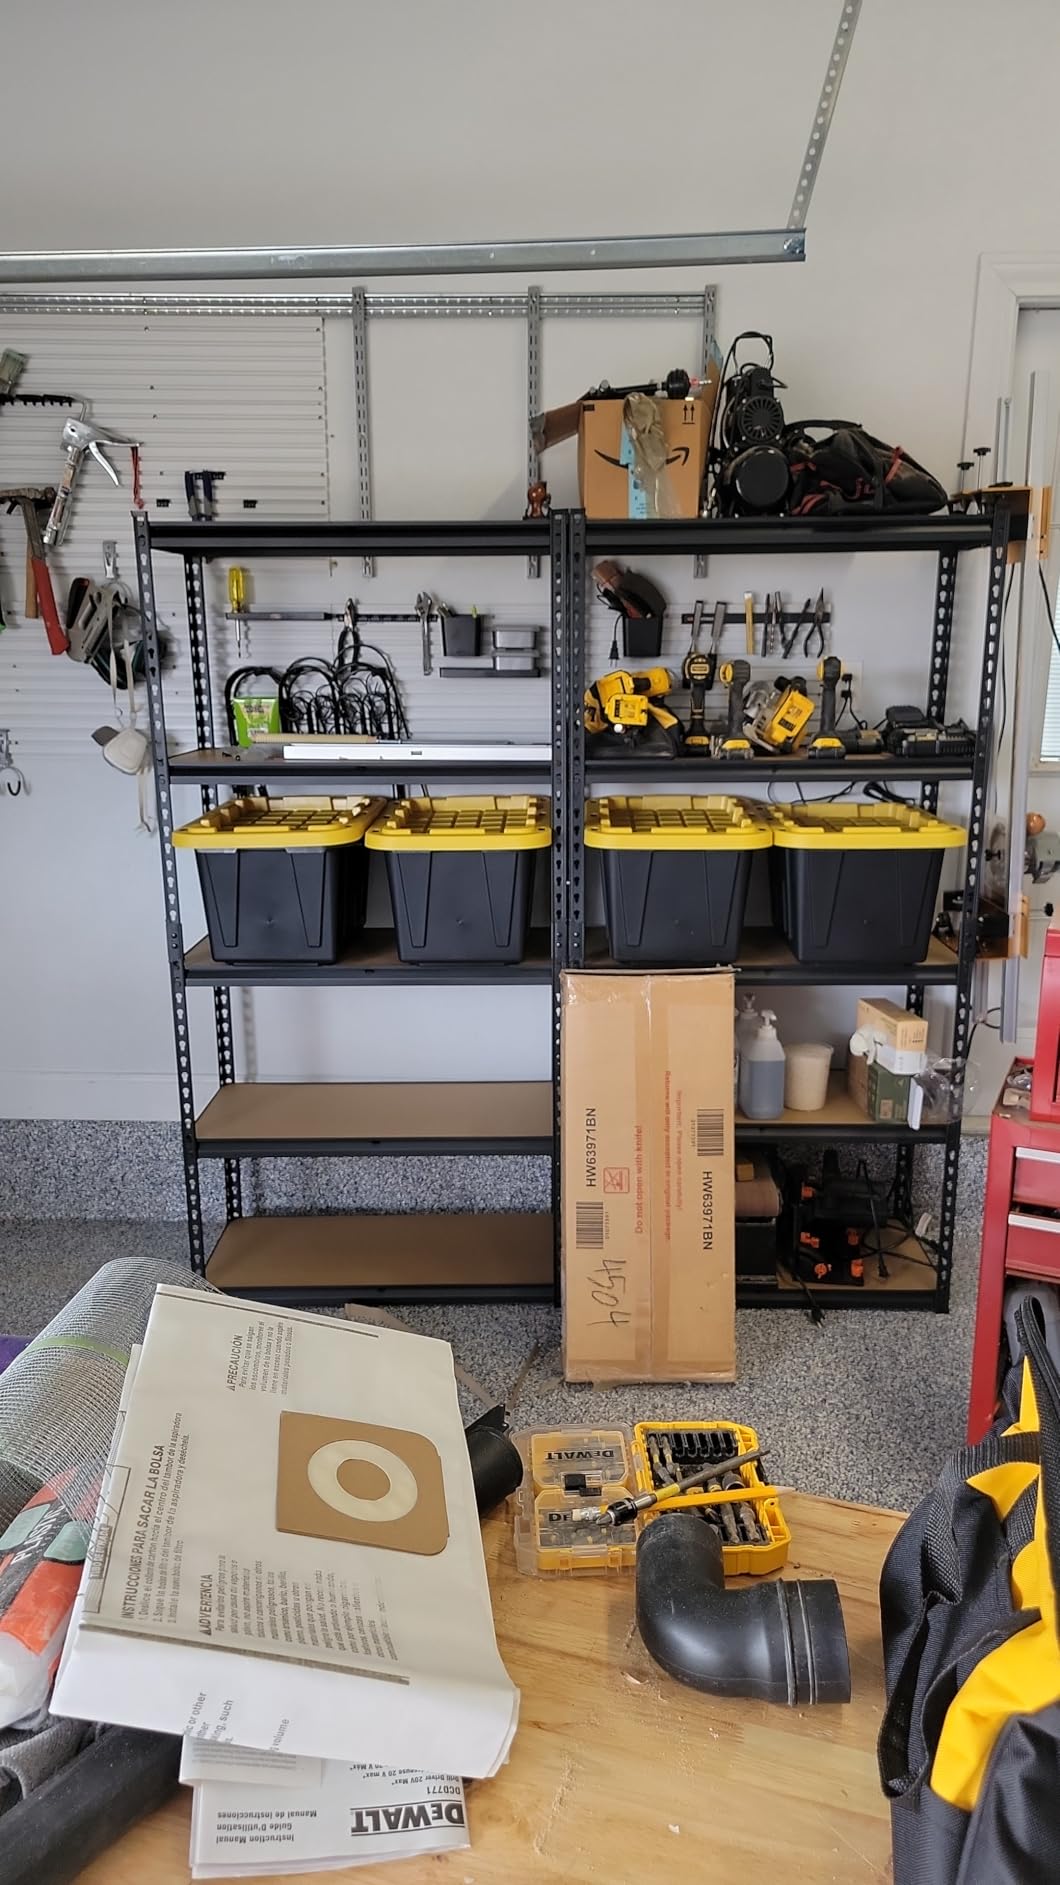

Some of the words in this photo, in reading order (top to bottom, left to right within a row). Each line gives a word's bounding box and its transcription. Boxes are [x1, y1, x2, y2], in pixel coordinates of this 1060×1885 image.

[585, 1107, 597, 1187] HW63971BN
[634, 1125, 643, 1152] knife!
[634, 1154, 643, 1174] with
[635, 1177, 644, 1200] open
[634, 1202, 643, 1218] not
[702, 1171, 713, 1250] HW63971BN
[634, 1220, 643, 1234] Do
[226, 1334, 243, 1384] PRECAUCIÓN
[248, 1382, 257, 1390] los
[170, 1412, 182, 1442] aspiradora
[148, 1445, 164, 1475] BOLSA
[167, 1448, 175, 1456] de
[546, 1449, 615, 1460] DEWALT
[163, 1456, 174, 1479] tambor
[145, 1477, 158, 1489] LA
[160, 1479, 169, 1490] del
[156, 1491, 166, 1515] centro
[165, 1515, 175, 1525] de
[171, 1469, 184, 1506] aspiradora
[137, 1490, 155, 1528] SACAR
[153, 1515, 162, 1523] el
[131, 1530, 147, 1554] PARA
[121, 1555, 143, 1619] INSTRUCCIONES
[198, 1574, 213, 1628] ADVERTENCIA
[192, 1692, 207, 1715] other
[219, 1700, 233, 1721] such
[188, 1716, 197, 1724] or
[272, 1719, 290, 1746] volume
[426, 1785, 461, 1794] DCD771
[274, 1811, 286, 1819] de
[287, 1809, 317, 1818] Manual
[351, 1802, 465, 1833] DEWALT
[268, 1822, 292, 1831] Guide
[215, 1834, 247, 1844] Manual
[248, 1833, 295, 1843] Instruction
